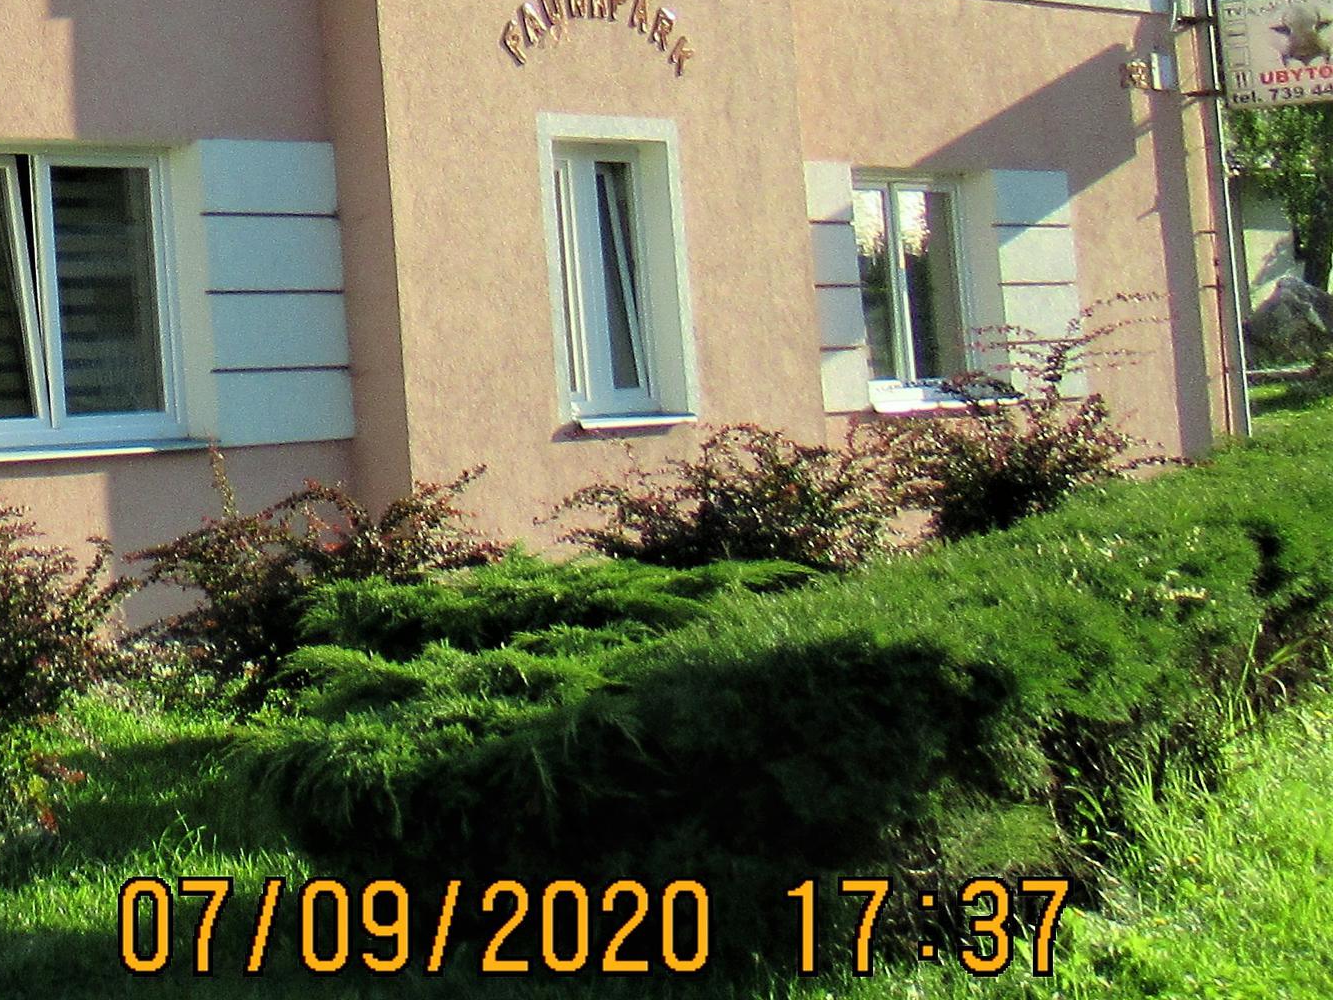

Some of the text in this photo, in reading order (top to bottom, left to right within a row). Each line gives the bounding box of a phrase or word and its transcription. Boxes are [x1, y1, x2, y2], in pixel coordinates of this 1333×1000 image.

[1259, 64, 1333, 84] UBYTO
[1233, 90, 1262, 104] tel.
[1269, 87, 1305, 101] 739
